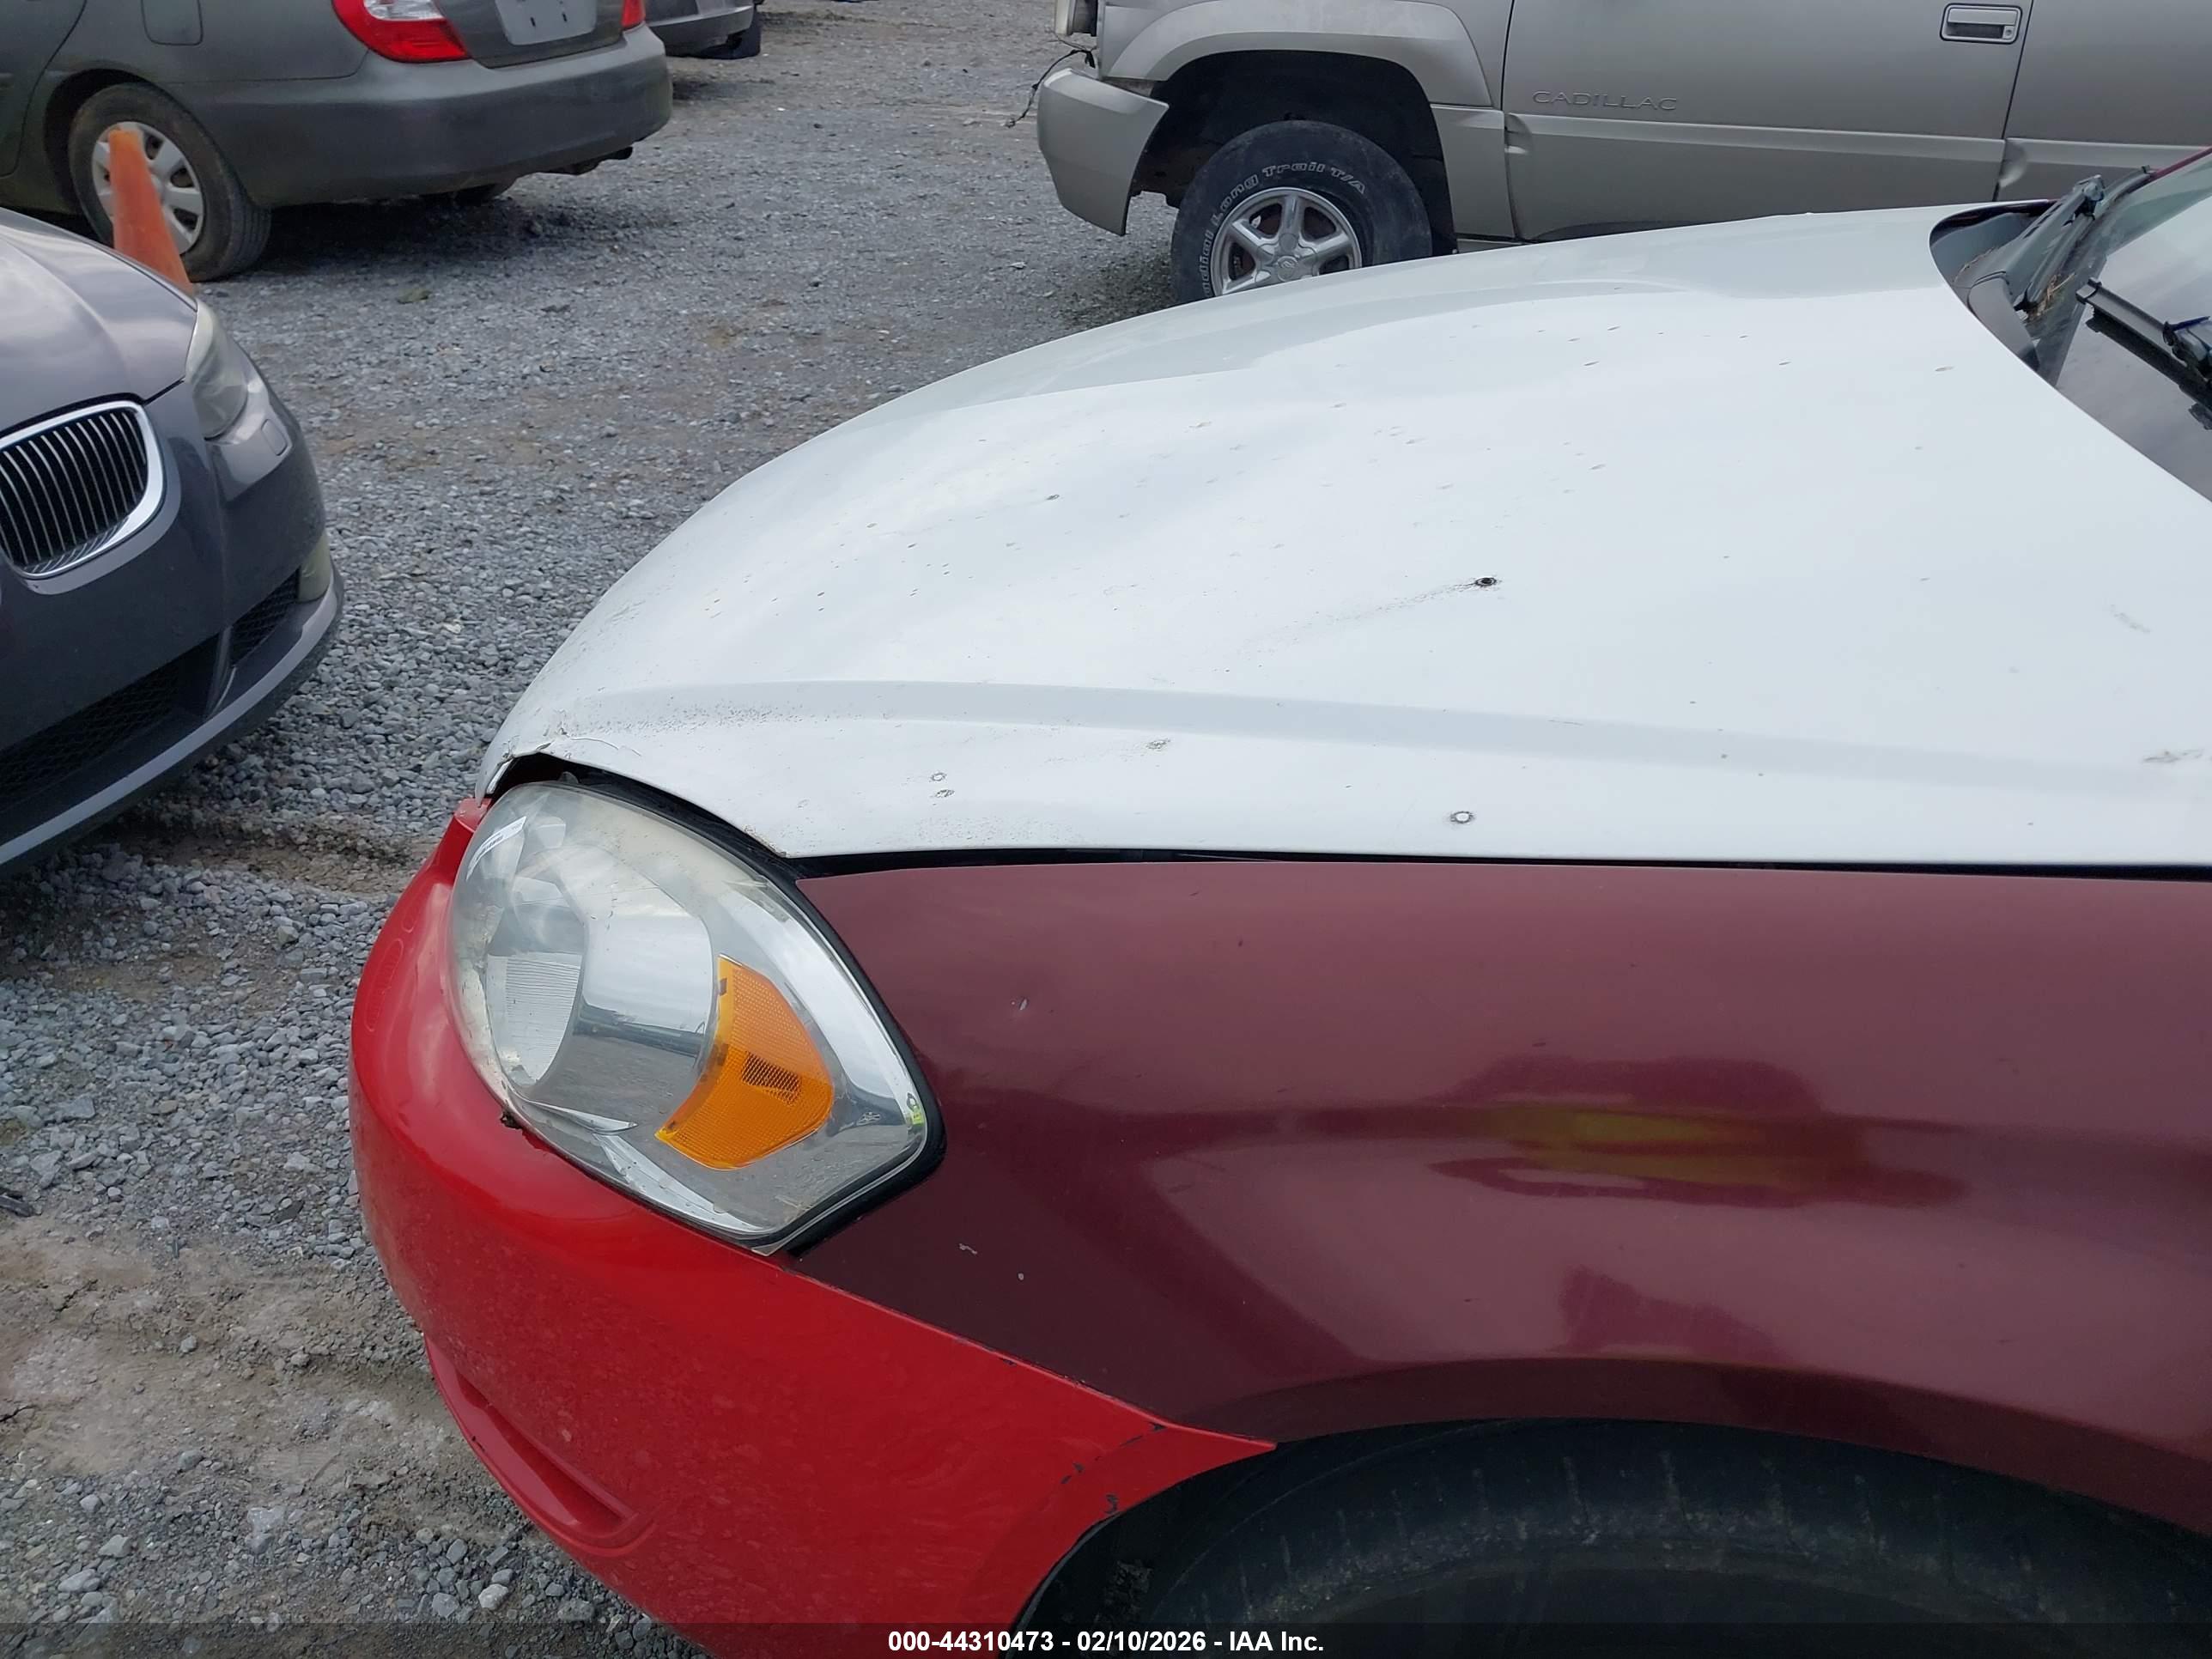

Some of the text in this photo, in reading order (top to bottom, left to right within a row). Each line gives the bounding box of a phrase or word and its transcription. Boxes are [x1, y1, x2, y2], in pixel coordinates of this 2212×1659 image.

[1532, 90, 1677, 111] CADILLAC
[1199, 161, 1366, 297] adial Long Trail T/A
